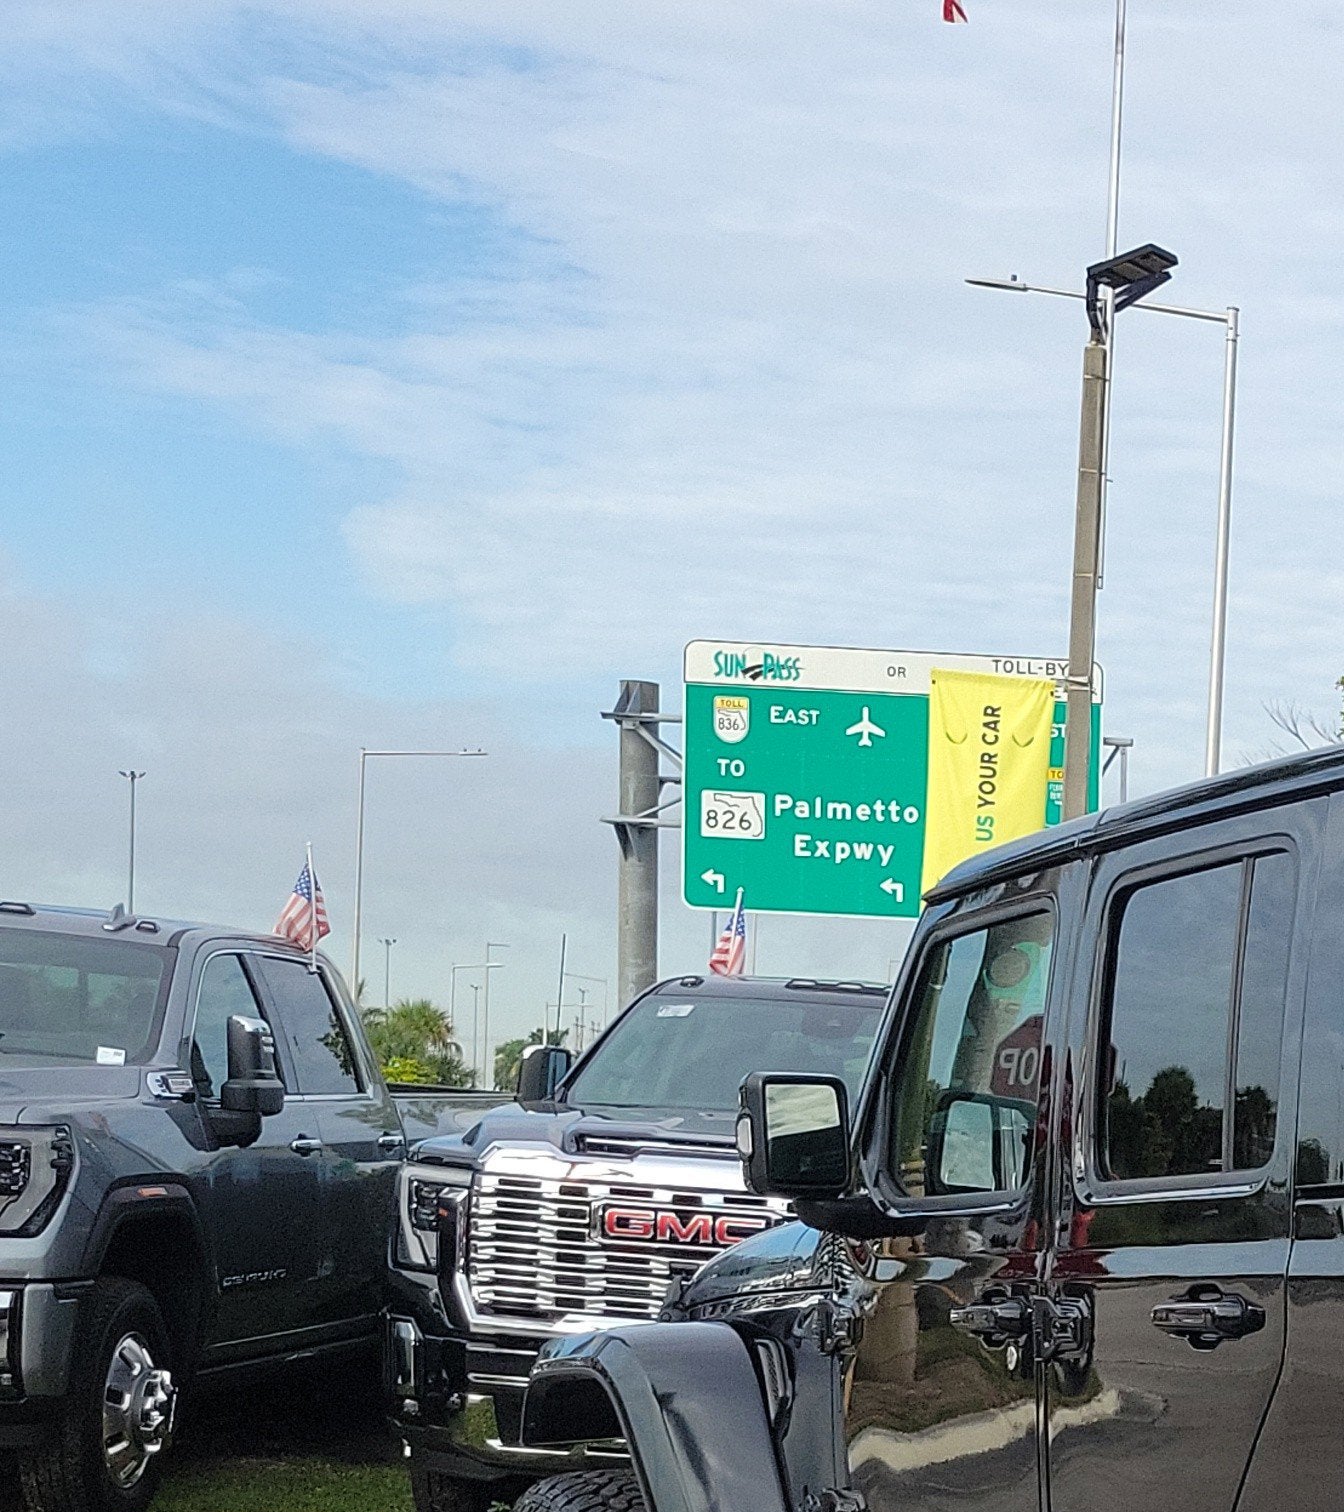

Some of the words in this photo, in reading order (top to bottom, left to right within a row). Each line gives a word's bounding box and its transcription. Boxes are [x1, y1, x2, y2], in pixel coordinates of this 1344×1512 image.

[886, 666, 907, 678] OR
[720, 699, 744, 708] TOLL
[770, 705, 820, 725] EAST
[718, 717, 740, 731] 836
[981, 704, 1002, 746] CAR
[717, 758, 745, 777] TO
[977, 752, 999, 809] YOUR
[705, 809, 752, 831] 826
[774, 793, 920, 824] Palmetto
[975, 815, 995, 842] US
[793, 833, 895, 867] Expwy
[604, 1207, 766, 1245] GMC
